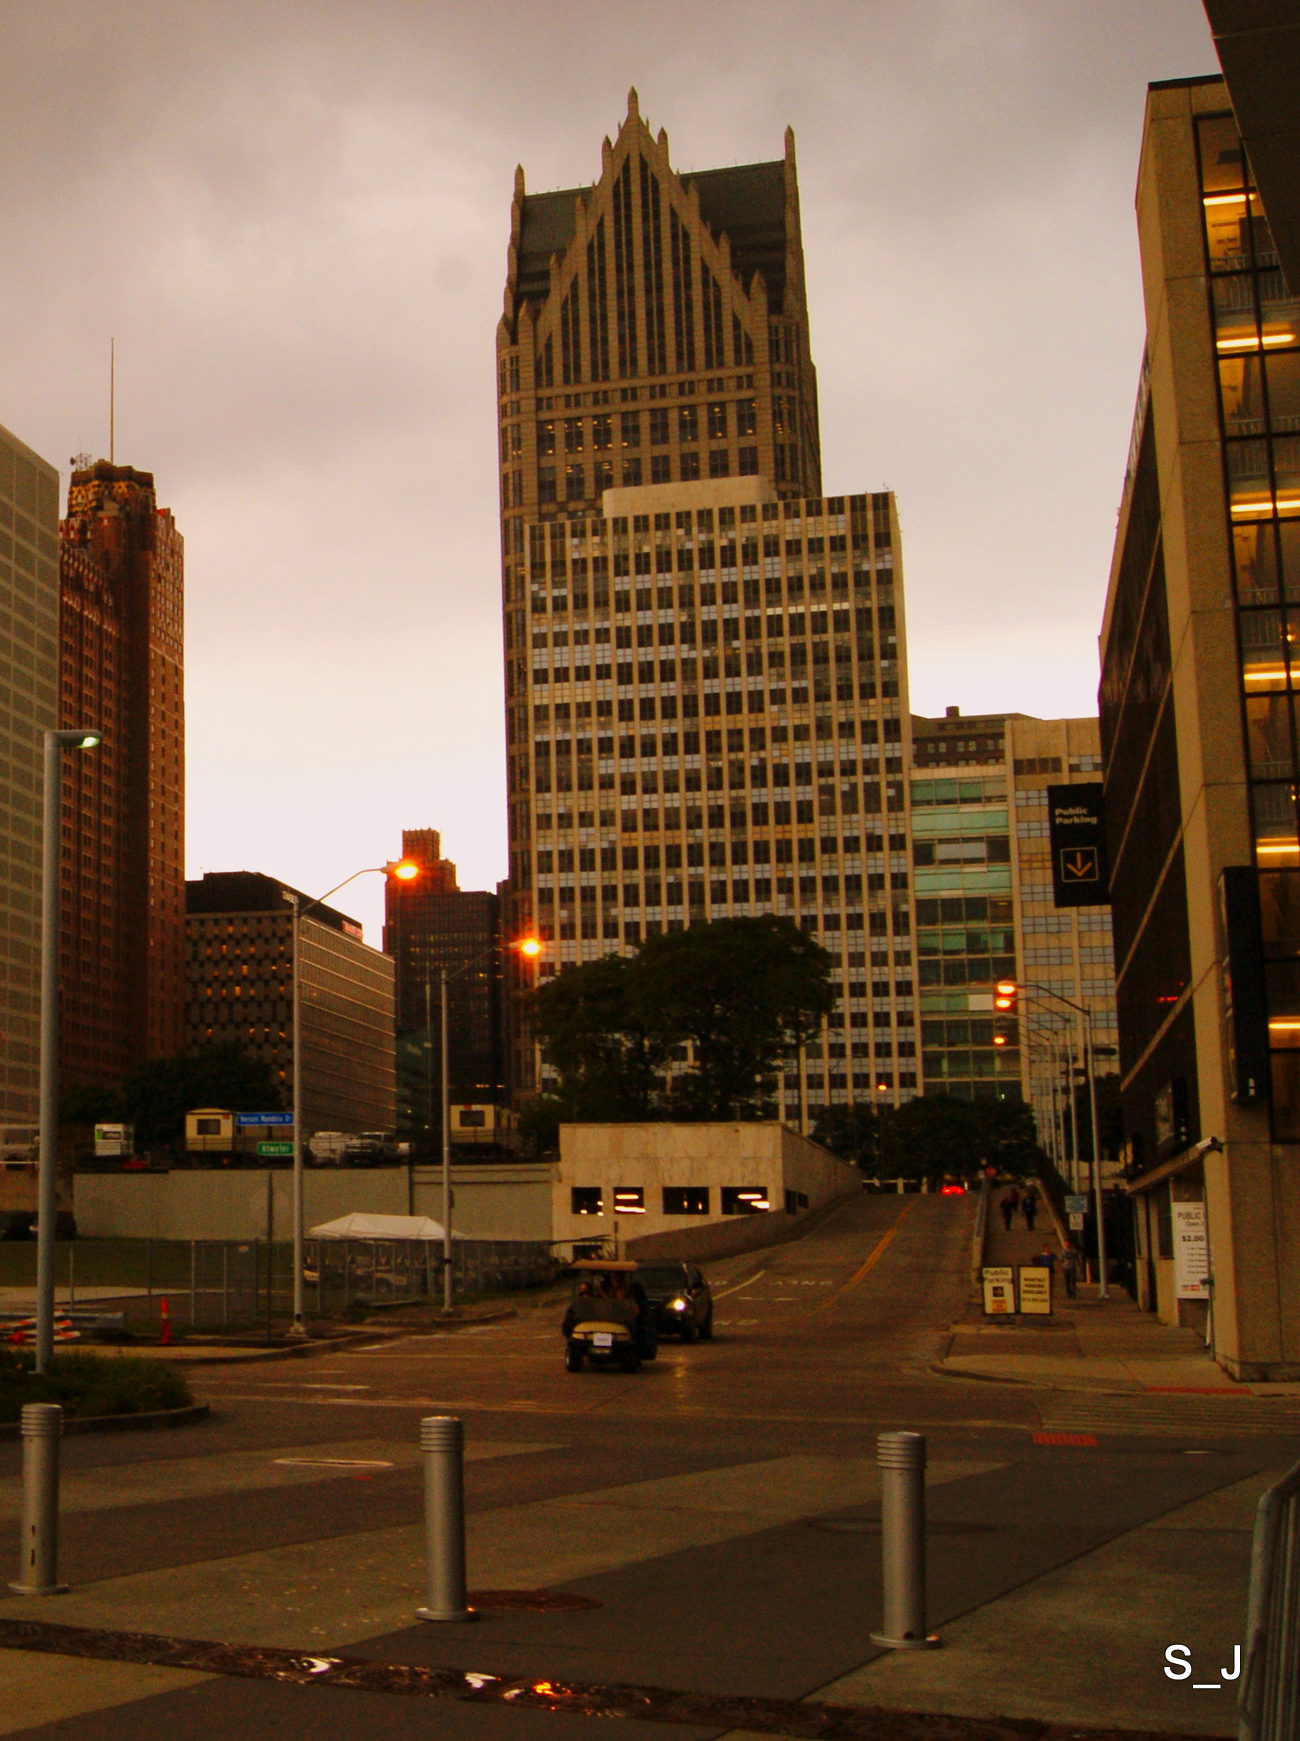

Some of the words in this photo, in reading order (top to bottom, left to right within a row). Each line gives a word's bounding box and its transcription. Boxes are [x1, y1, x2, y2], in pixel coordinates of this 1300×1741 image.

[1055, 806, 1089, 816] Public
[1055, 816, 1098, 825] Parking
[261, 1145, 290, 1153] Atwater
[1178, 1212, 1202, 1220] PUBLIC
